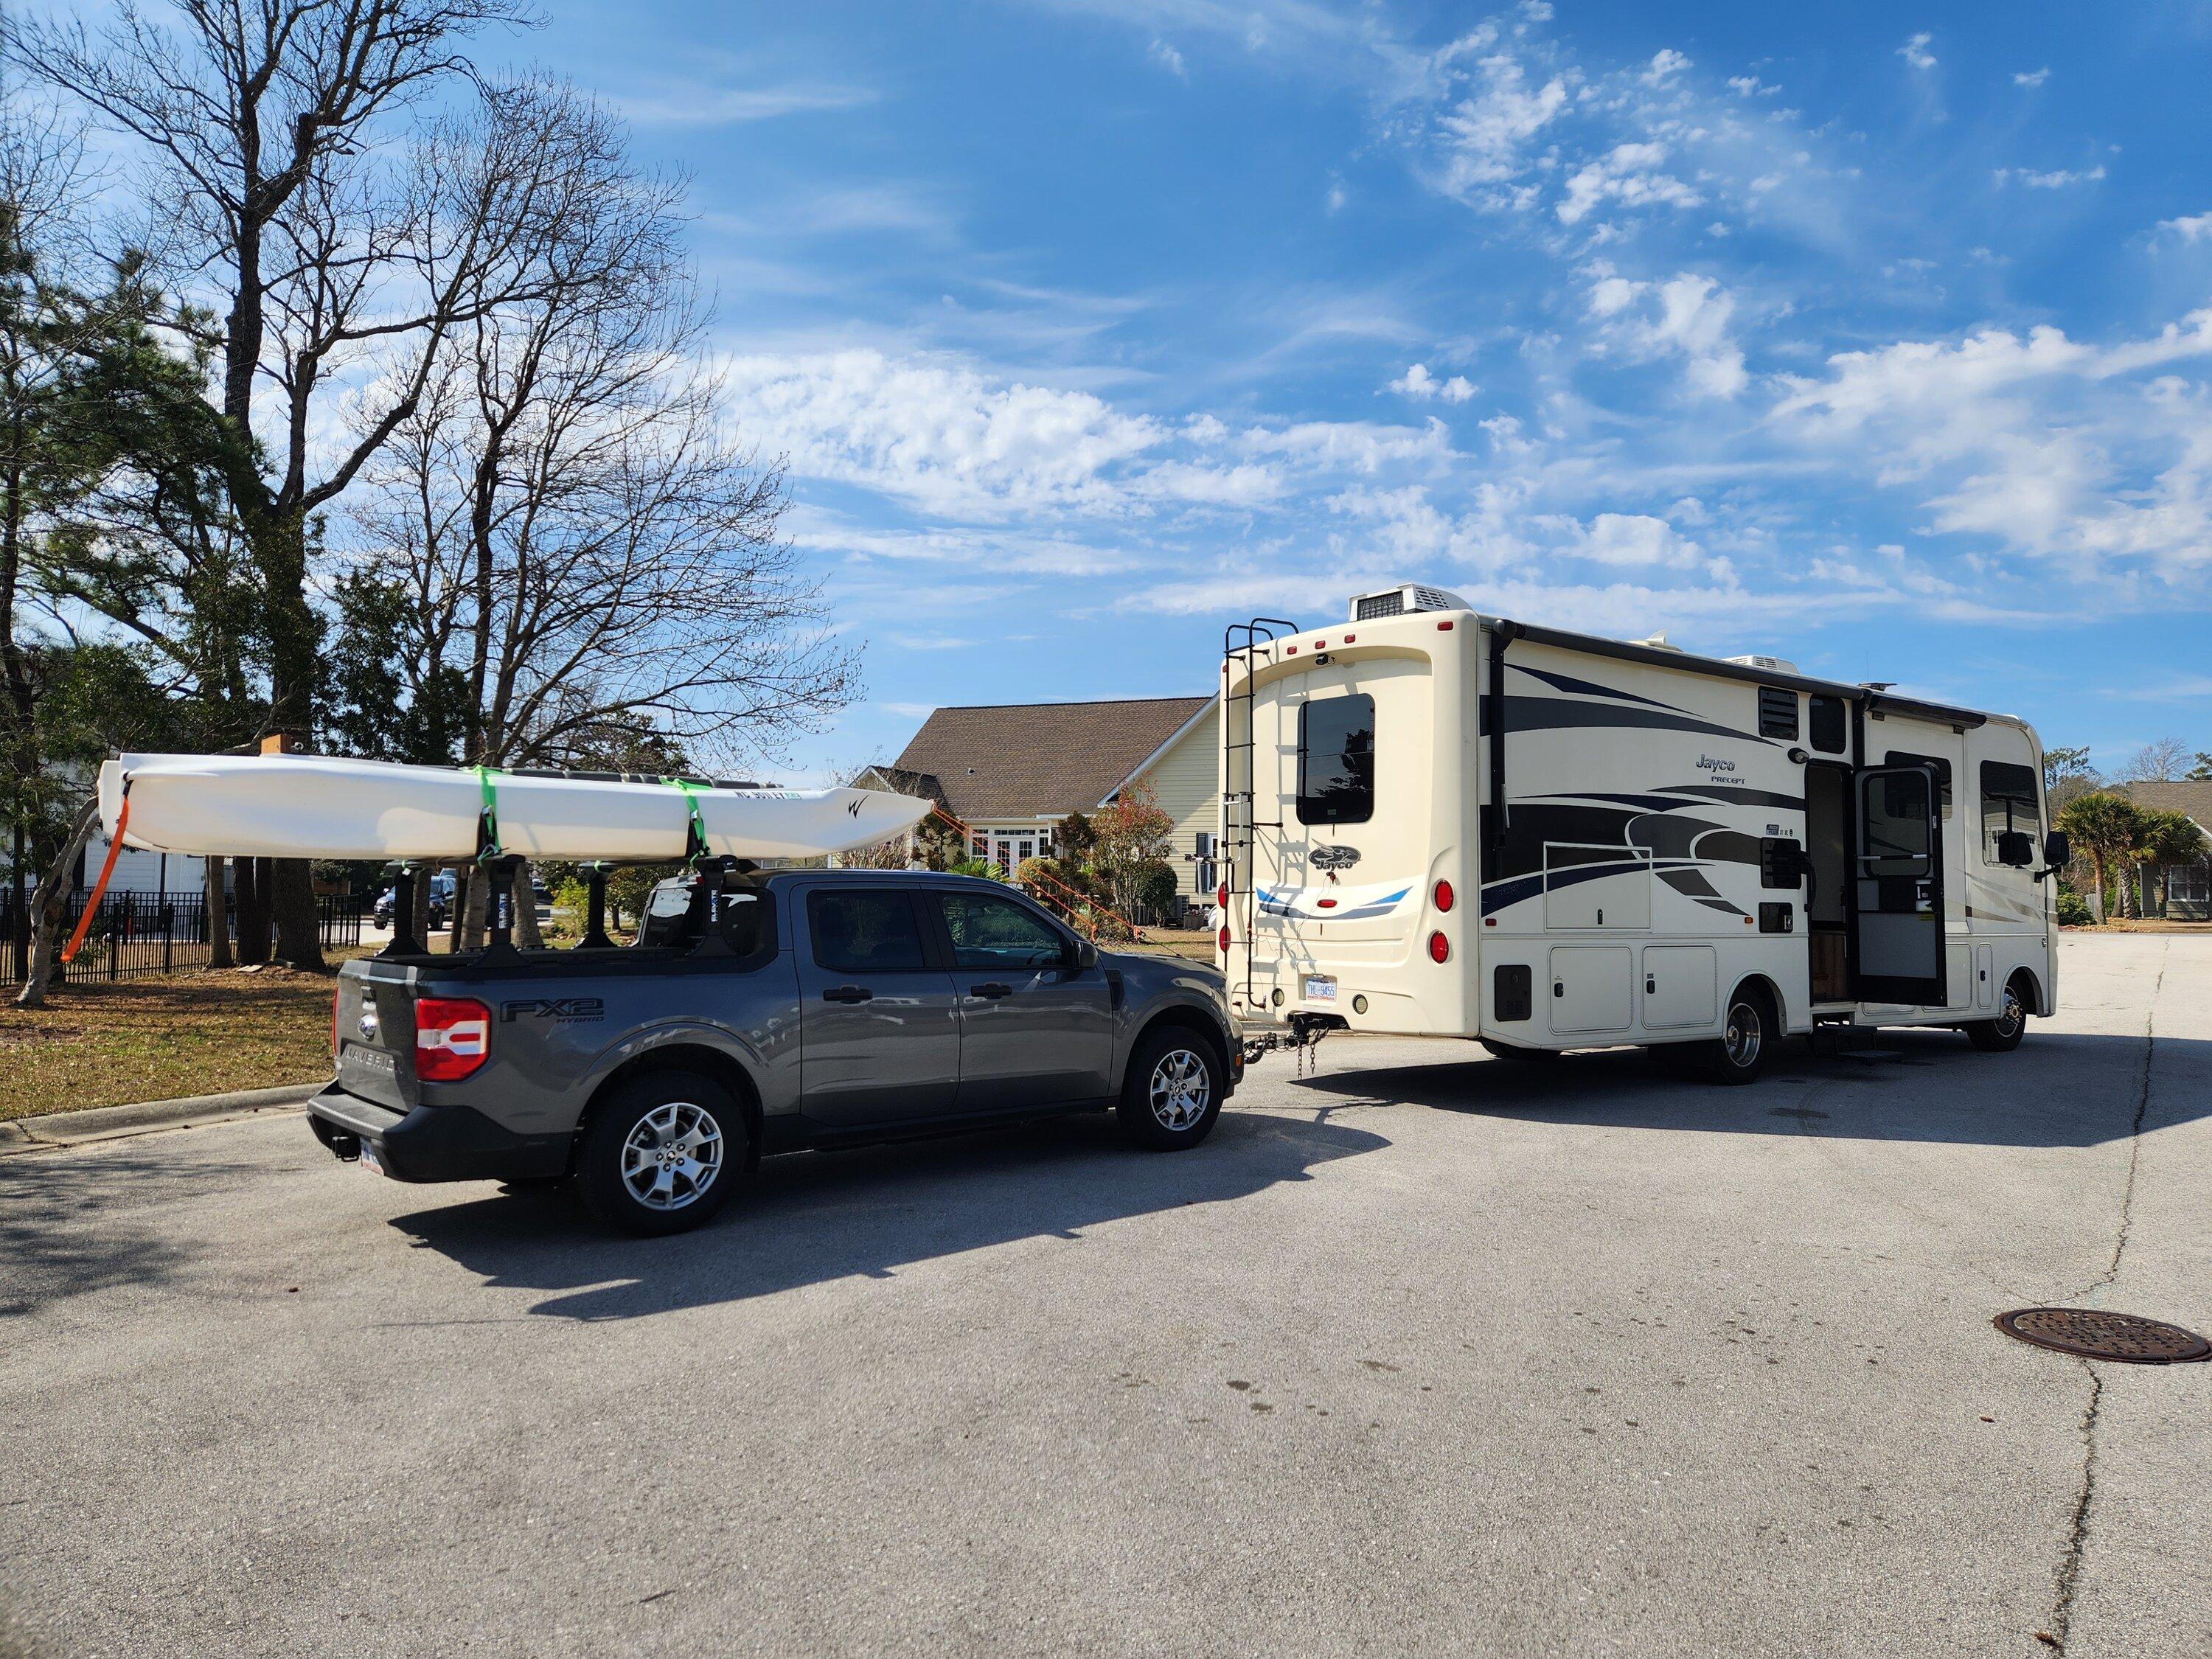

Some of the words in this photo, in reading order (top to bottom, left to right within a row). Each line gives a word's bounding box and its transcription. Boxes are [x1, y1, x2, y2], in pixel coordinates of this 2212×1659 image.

[1695, 754, 1736, 772] Jayco
[1711, 776, 1746, 785] PRECEPT
[1315, 859, 1353, 871] Jayco
[498, 893, 507, 929] ELEVATE
[500, 998, 604, 1022] FX2
